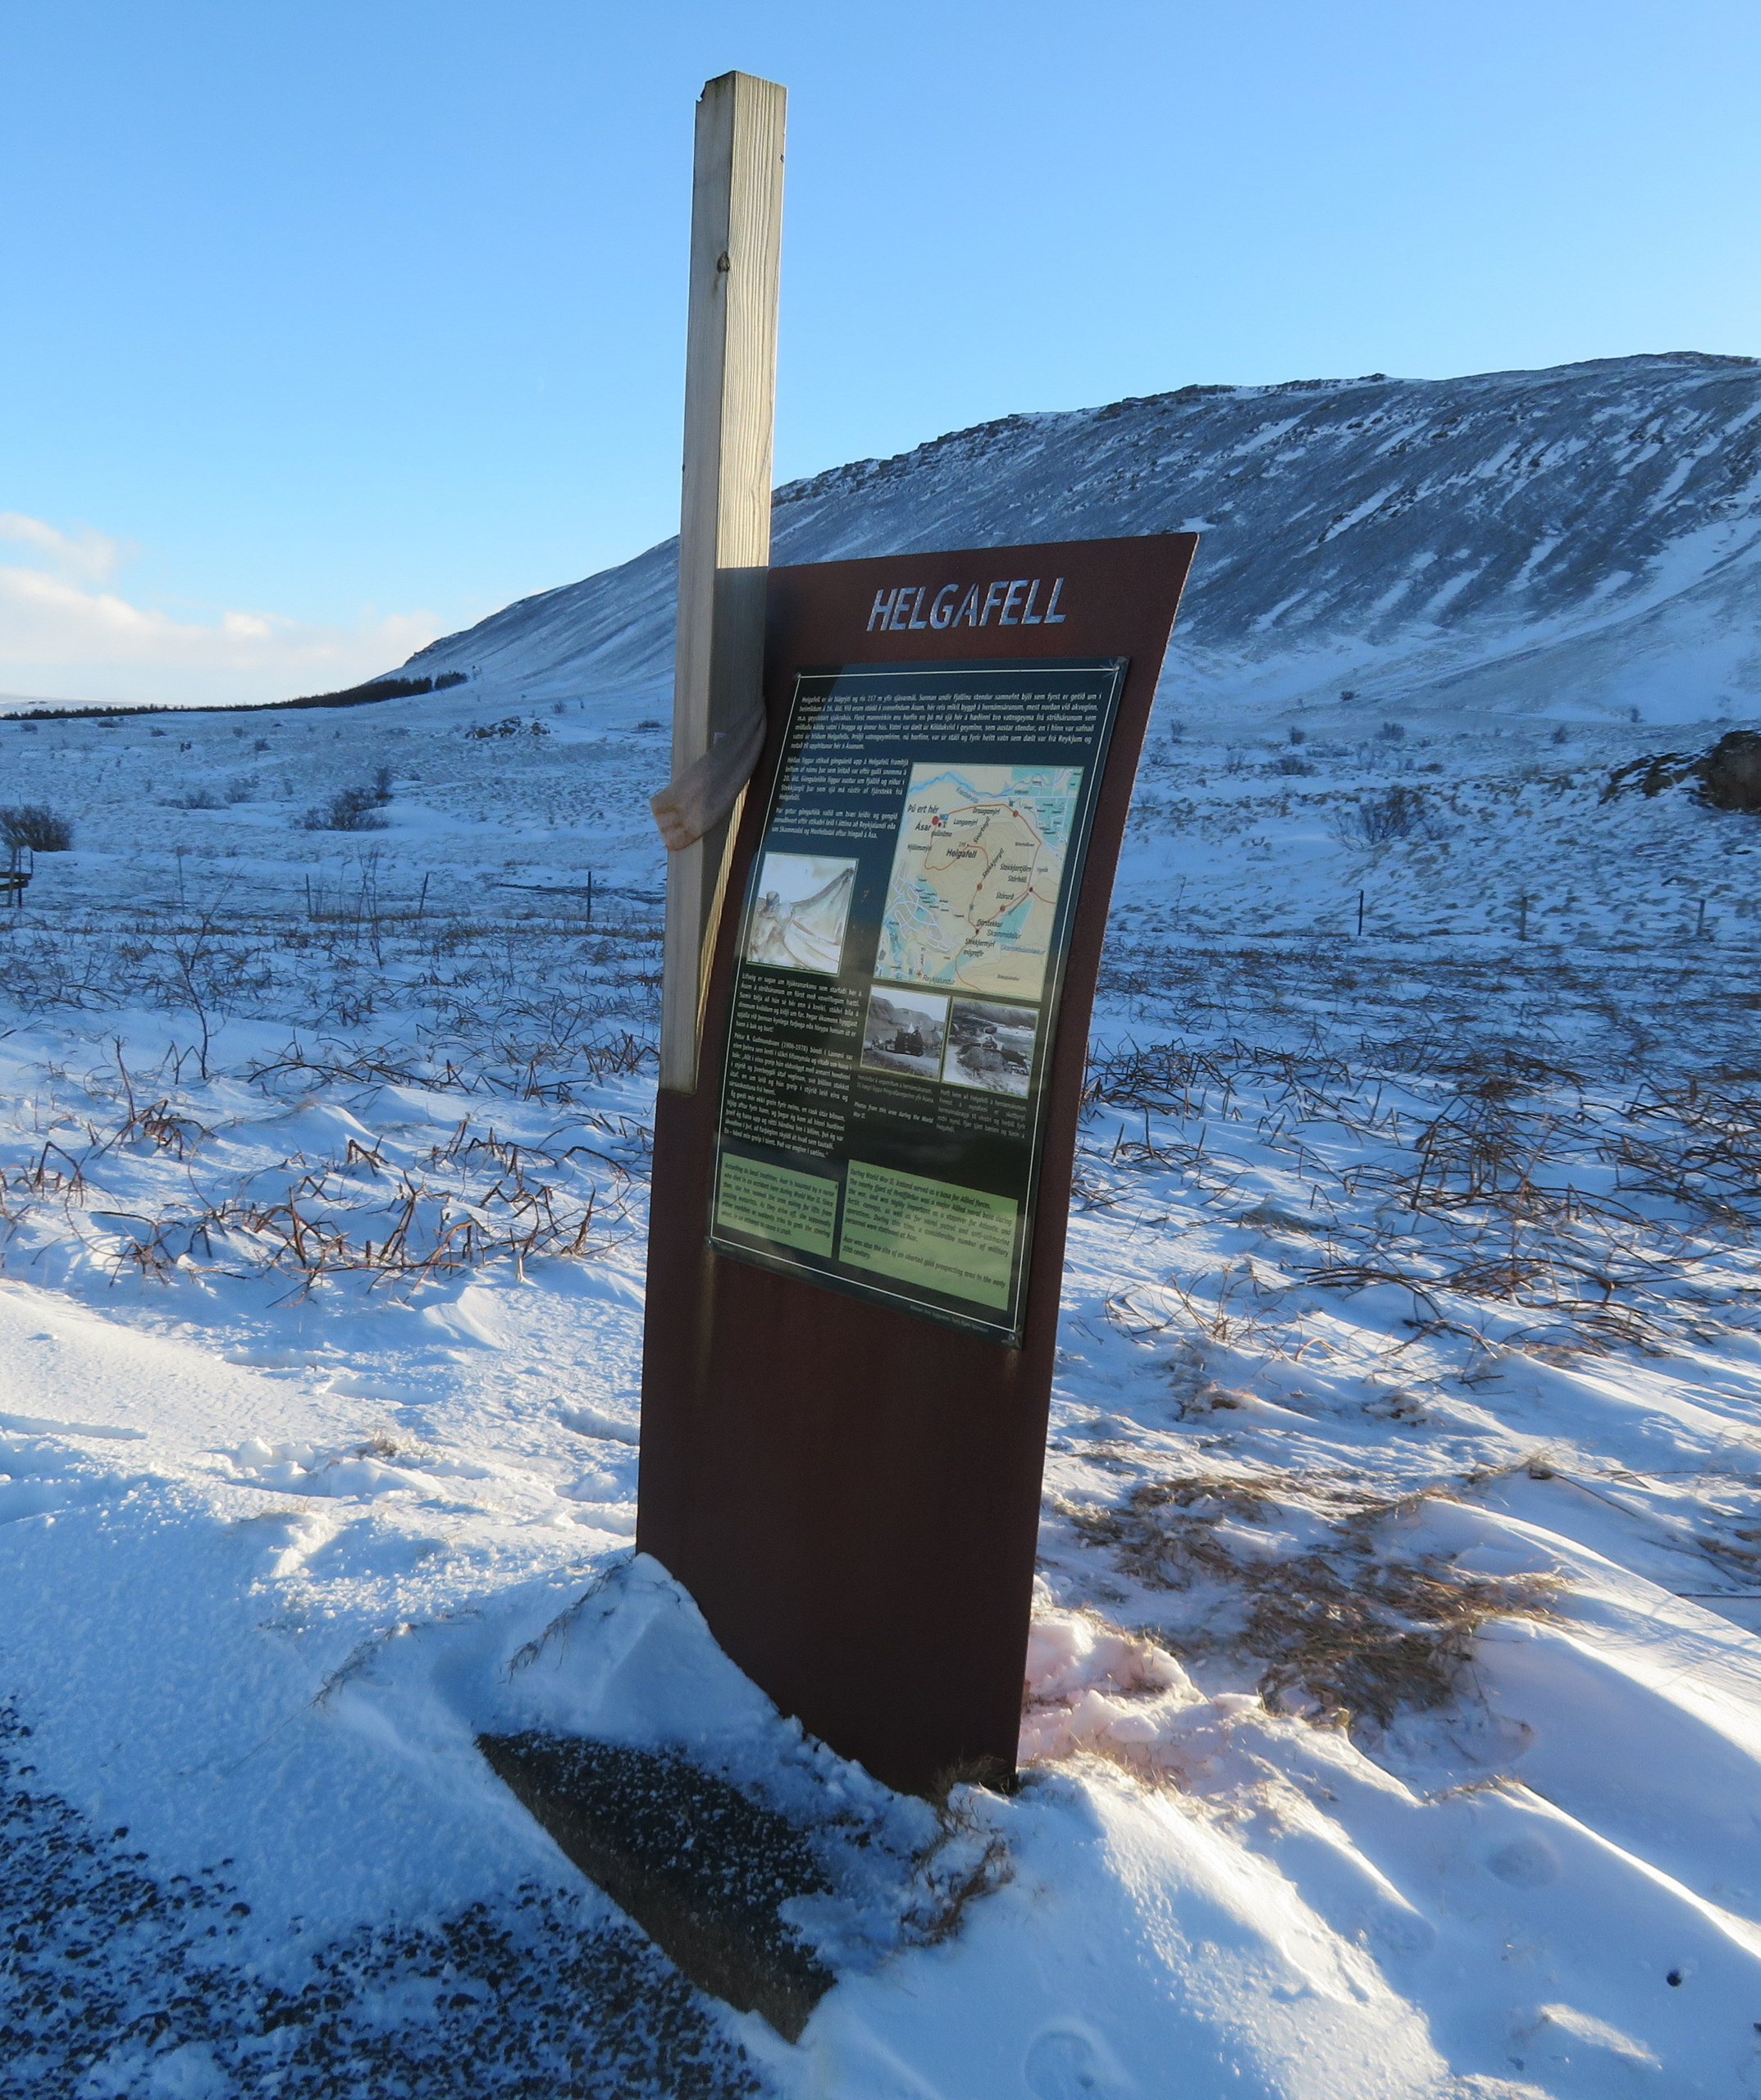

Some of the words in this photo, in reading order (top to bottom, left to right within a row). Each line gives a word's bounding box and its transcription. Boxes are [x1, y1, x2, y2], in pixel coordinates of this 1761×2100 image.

[866, 578, 1066, 632] HELGAFELL
[907, 804, 916, 812] Þú
[928, 804, 939, 814] hér
[915, 820, 932, 831] Ásar
[946, 848, 978, 860] Helgafell
[923, 975, 956, 986] Reykjalundur
